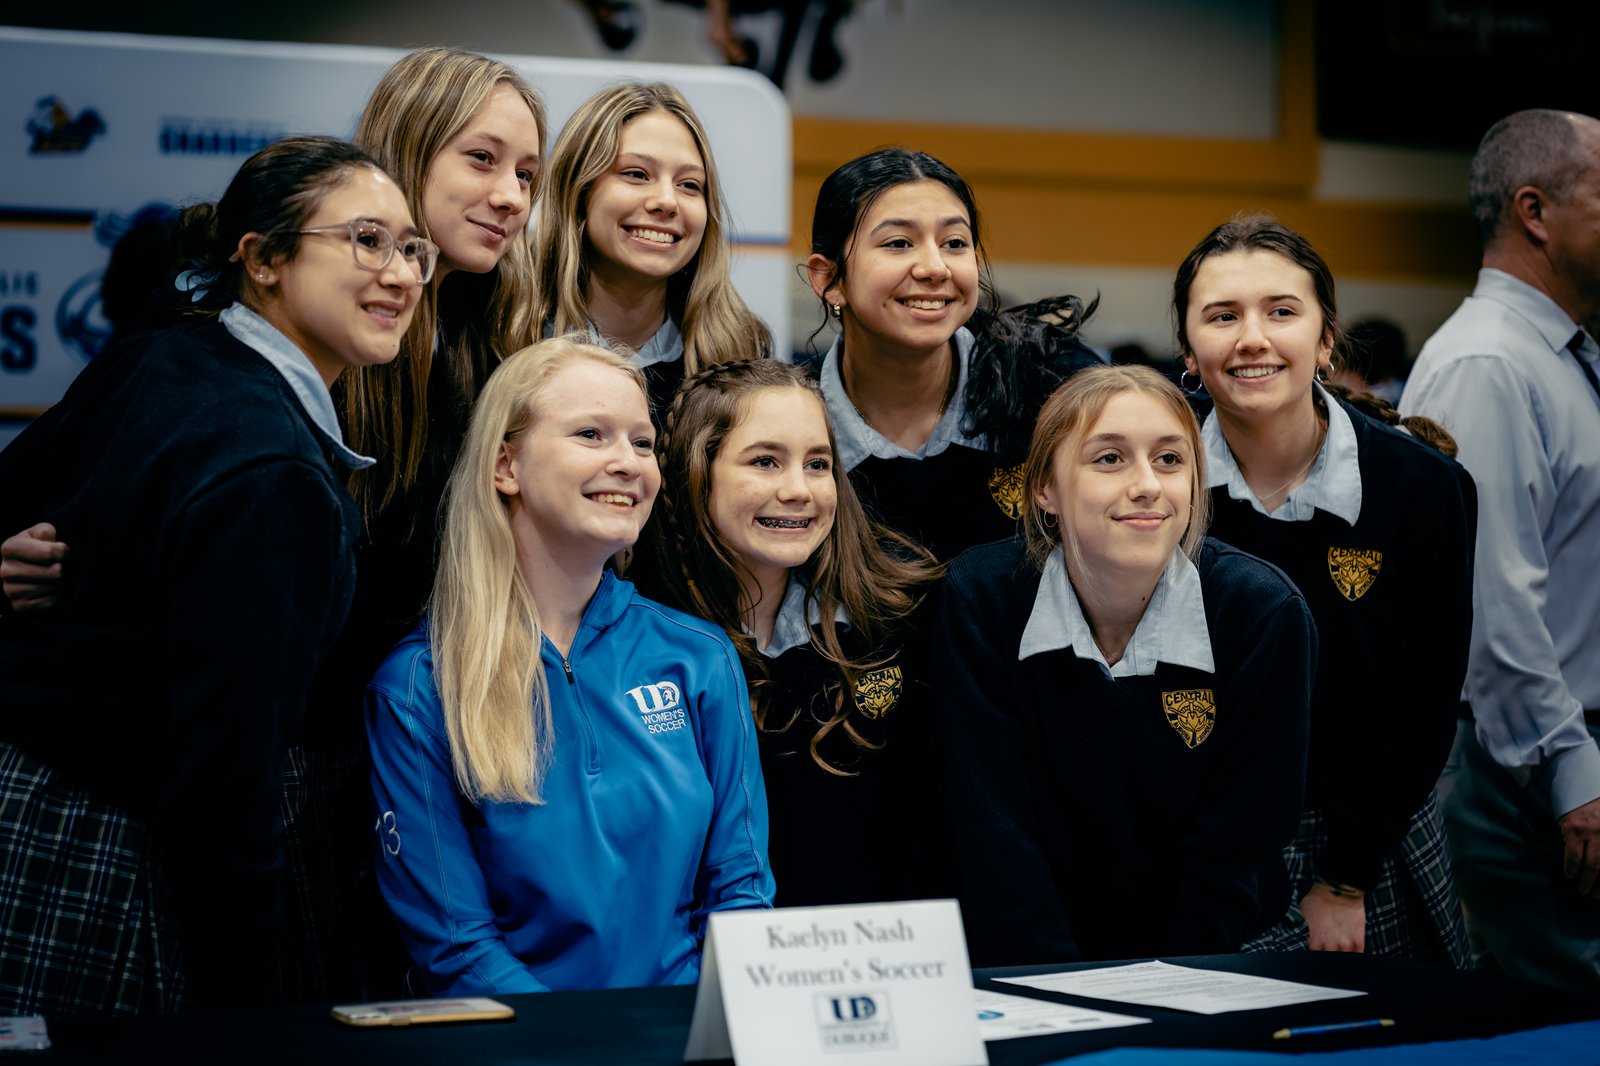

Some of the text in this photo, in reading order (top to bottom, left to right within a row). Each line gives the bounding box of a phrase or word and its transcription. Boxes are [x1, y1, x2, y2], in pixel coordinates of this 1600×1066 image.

[1331, 548, 1381, 562] CENTRAL
[625, 681, 680, 713] UD
[1166, 691, 1216, 706] CENTRAL
[641, 708, 685, 724] WOMEN'S
[648, 719, 686, 734] SOCCER
[767, 918, 914, 951] Kaelyn Nash
[745, 957, 945, 988] Women's Soccer
